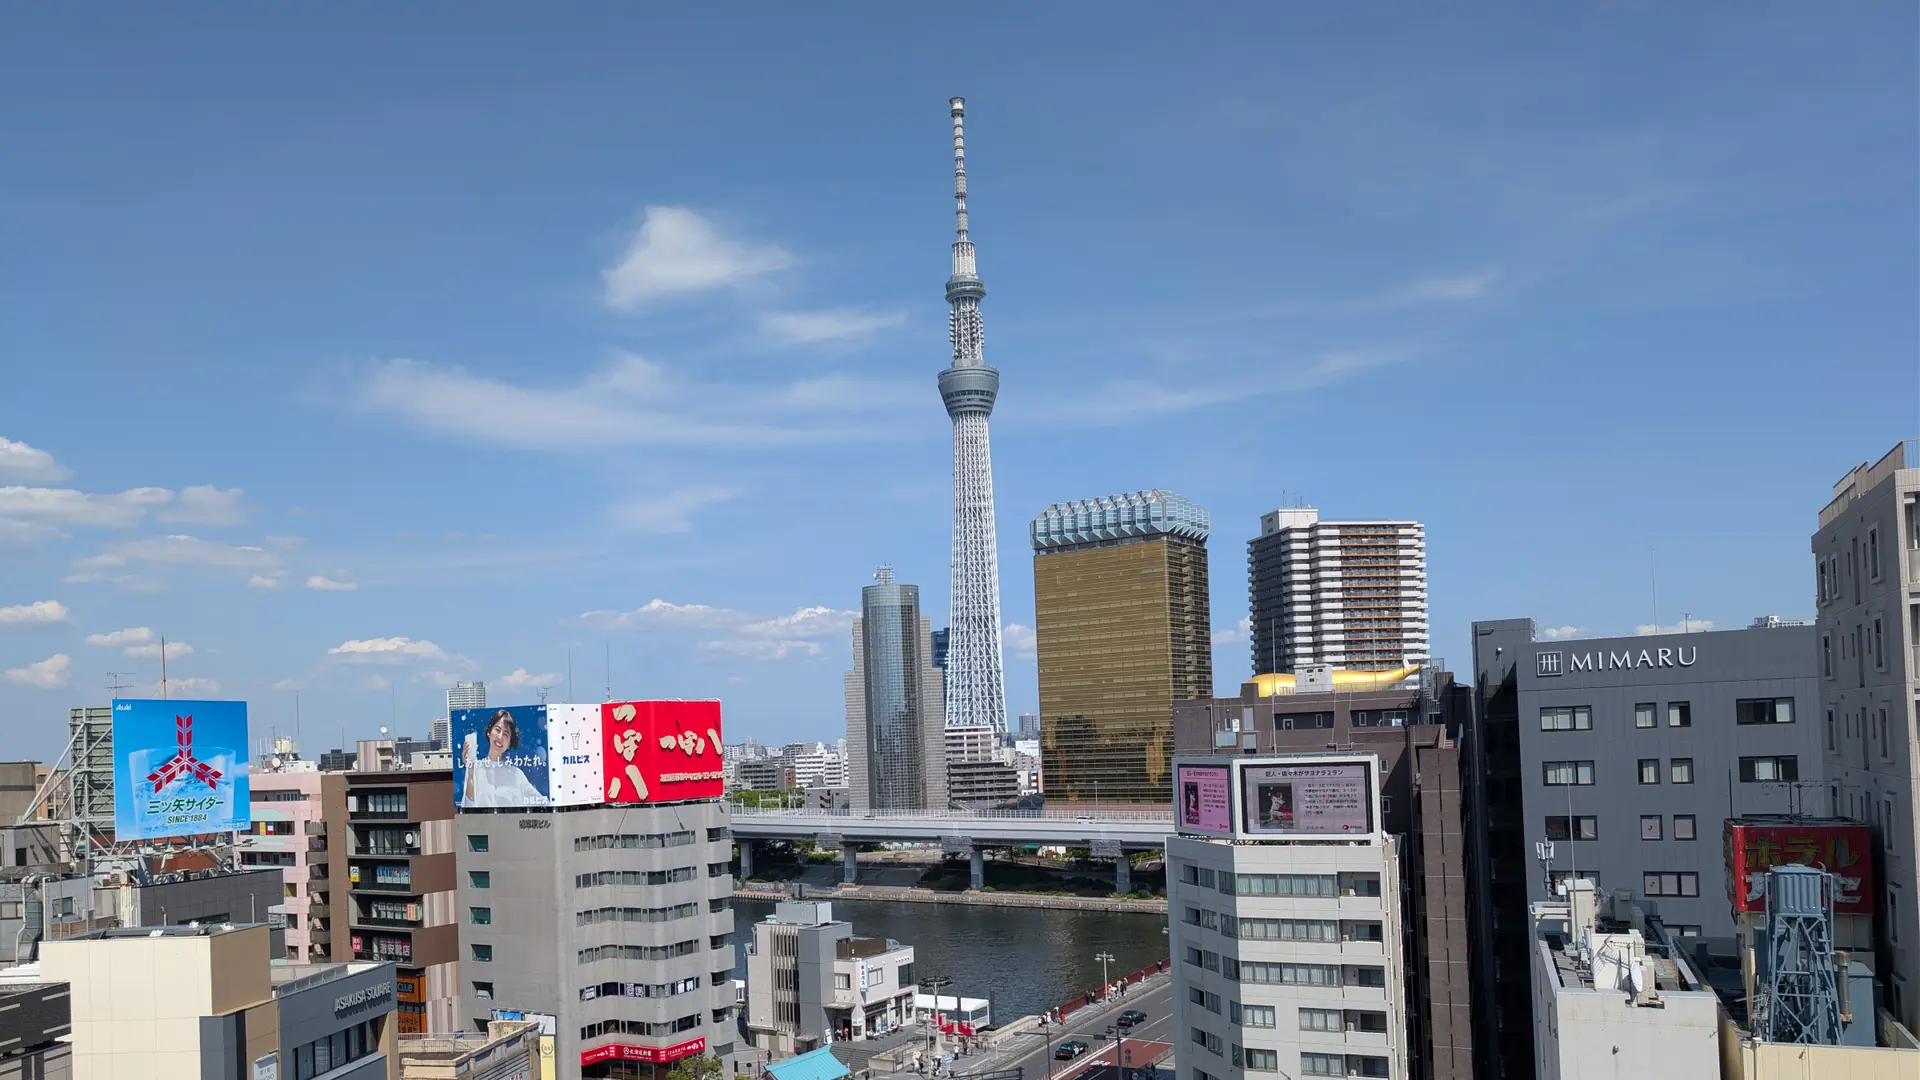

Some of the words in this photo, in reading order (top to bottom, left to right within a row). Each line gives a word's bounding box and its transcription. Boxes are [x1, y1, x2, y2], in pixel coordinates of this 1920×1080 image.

[1570, 647, 1697, 672] MIMARU
[457, 754, 547, 769] しあわせ、しみわたれ。
[562, 755, 591, 765] カルピス
[147, 796, 225, 815] 三ツ矢サイダー
[190, 813, 207, 821] 1884
[1745, 836, 1862, 868] ホテル
[335, 991, 367, 1012] ASAKUSA
